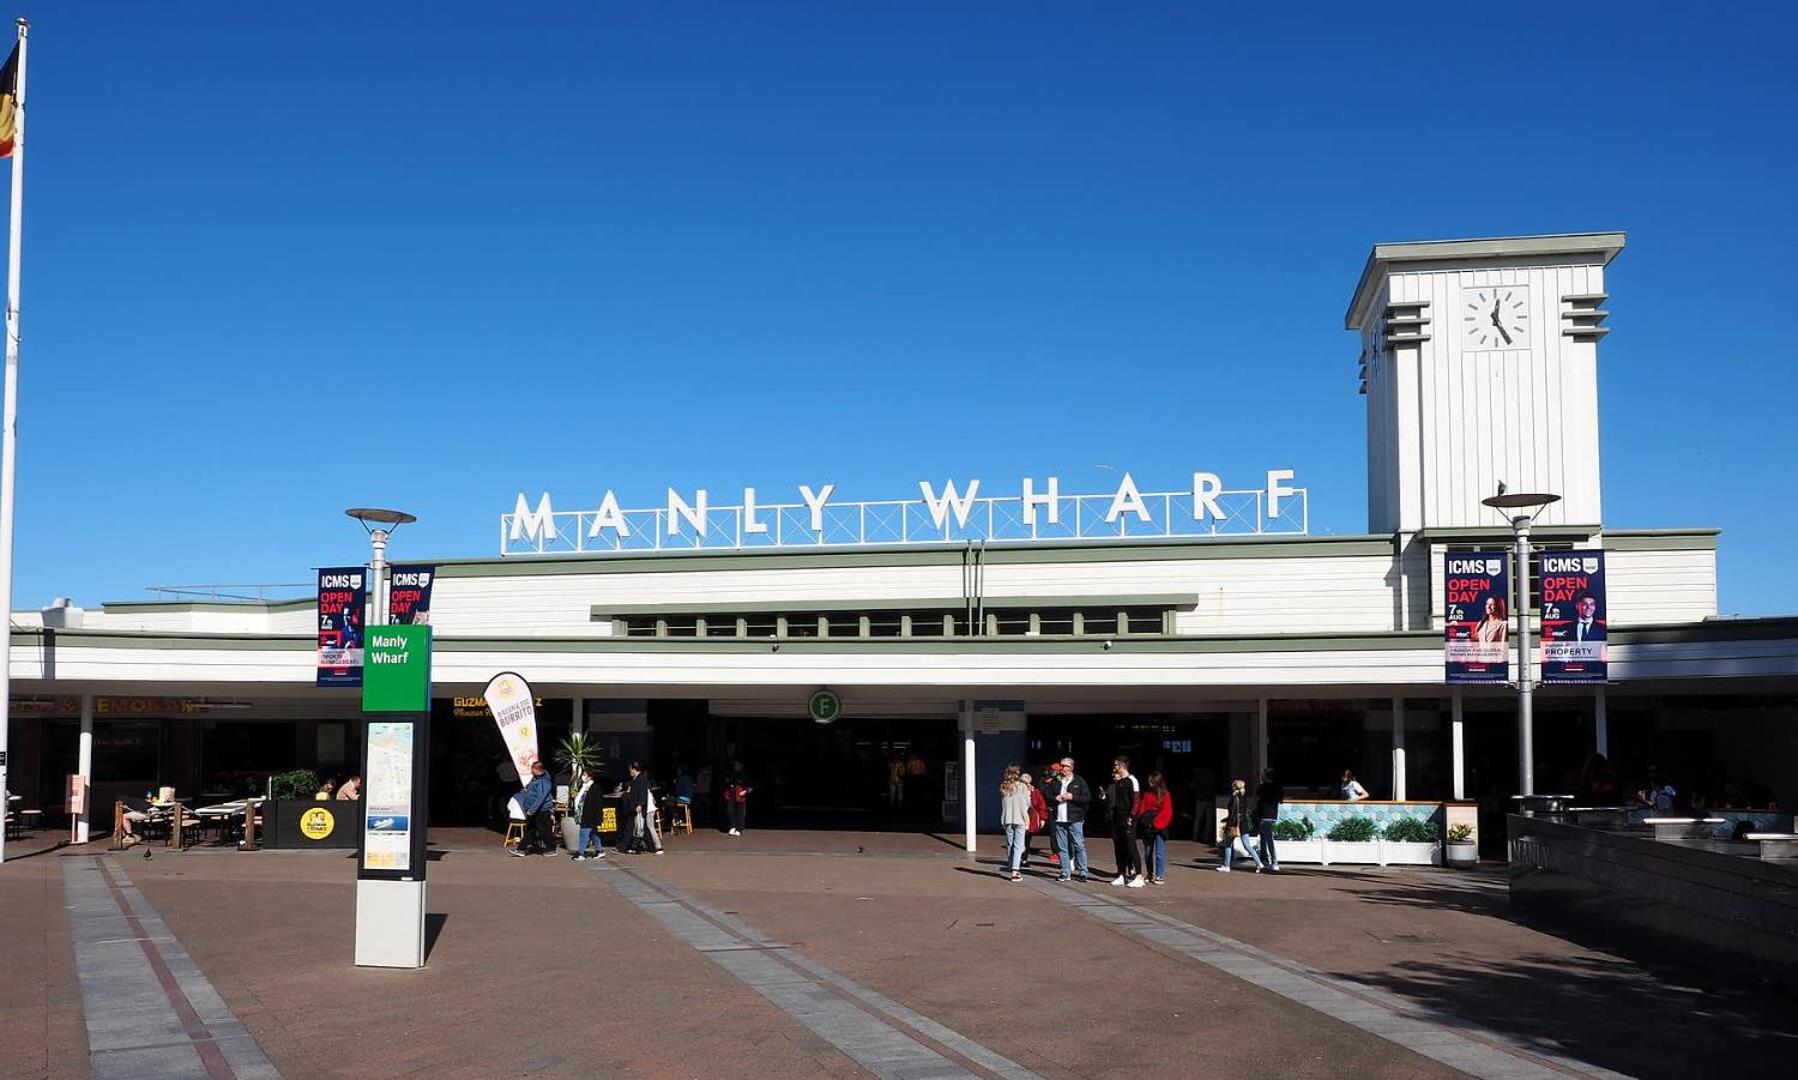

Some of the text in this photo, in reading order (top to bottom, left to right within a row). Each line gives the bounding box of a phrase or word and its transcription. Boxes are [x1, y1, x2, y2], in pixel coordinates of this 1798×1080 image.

[510, 469, 1294, 541] MANLY WHARF
[1448, 560, 1485, 574] ICMS
[1544, 558, 1581, 572] ICMS
[321, 574, 350, 588] ICMS
[392, 573, 419, 586] ICMS
[1448, 579, 1491, 591] OPEN
[1544, 577, 1588, 590] OPEN
[321, 592, 353, 603] OPEN
[391, 590, 421, 601] OPEN
[1448, 591, 1479, 603] DAY
[1544, 590, 1575, 602] DAY
[320, 603, 344, 614] DAY
[391, 602, 411, 613] DAY
[372, 635, 408, 650] Manly
[371, 651, 409, 664] Wharf
[1545, 647, 1593, 656] PROPERTY
[820, 698, 830, 715] F
[499, 705, 533, 728] BURRITO
